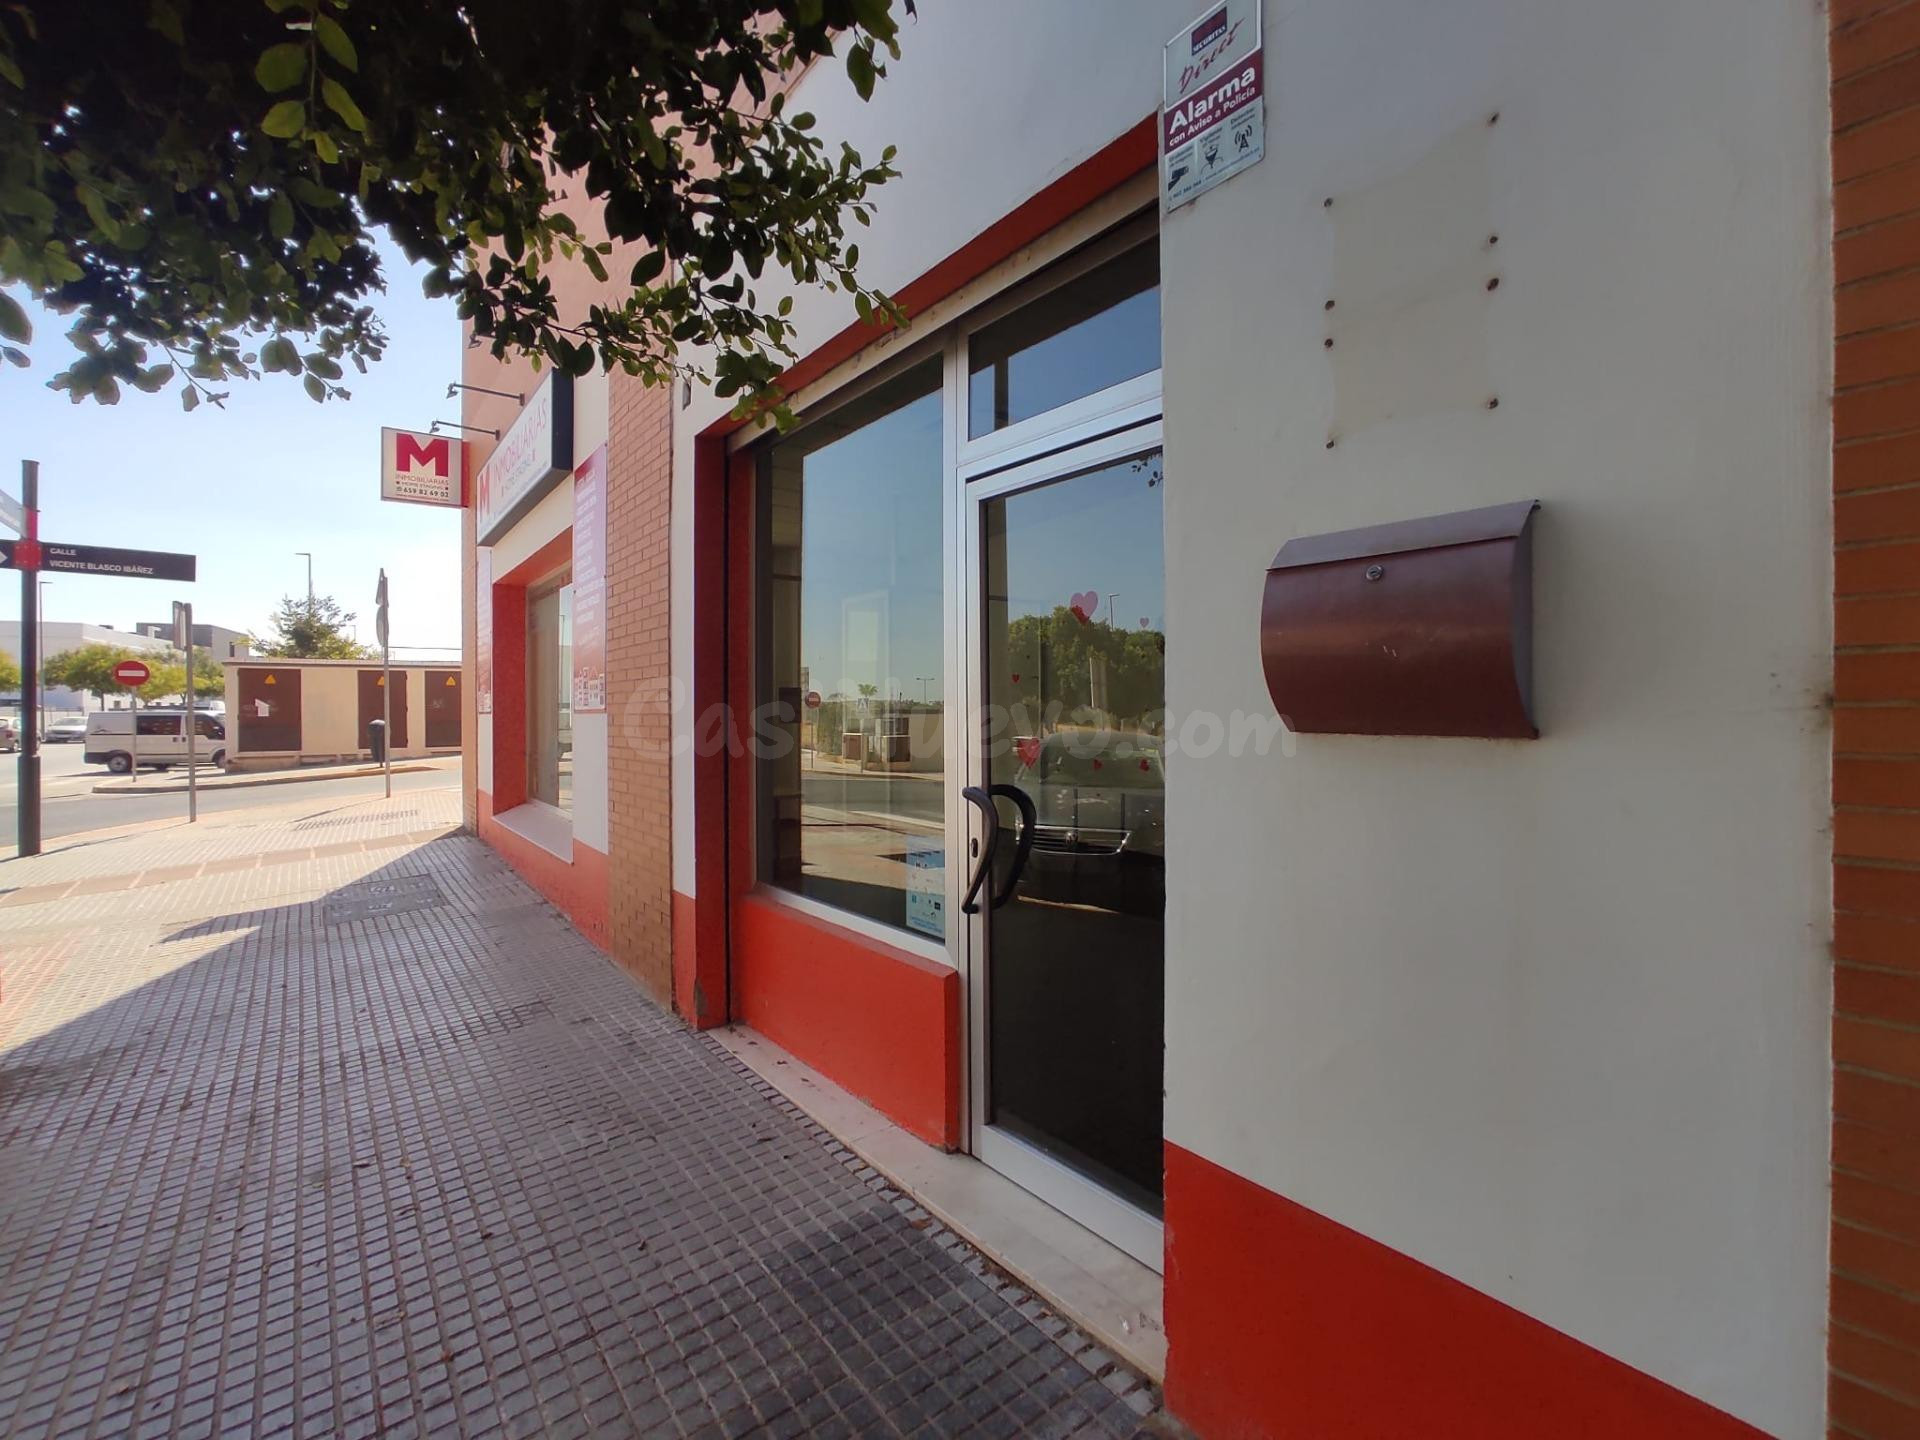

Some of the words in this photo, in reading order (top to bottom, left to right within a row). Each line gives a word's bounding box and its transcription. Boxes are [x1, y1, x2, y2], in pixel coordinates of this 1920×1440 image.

[1169, 66, 1256, 135] Alarma
[1169, 132, 1185, 146] con
[1188, 114, 1212, 136] Aviso
[1215, 110, 1221, 118] a
[396, 432, 448, 477] M
[49, 547, 77, 556] CALLE
[49, 559, 87, 569] VICENTE
[87, 562, 121, 572] BLASCO
